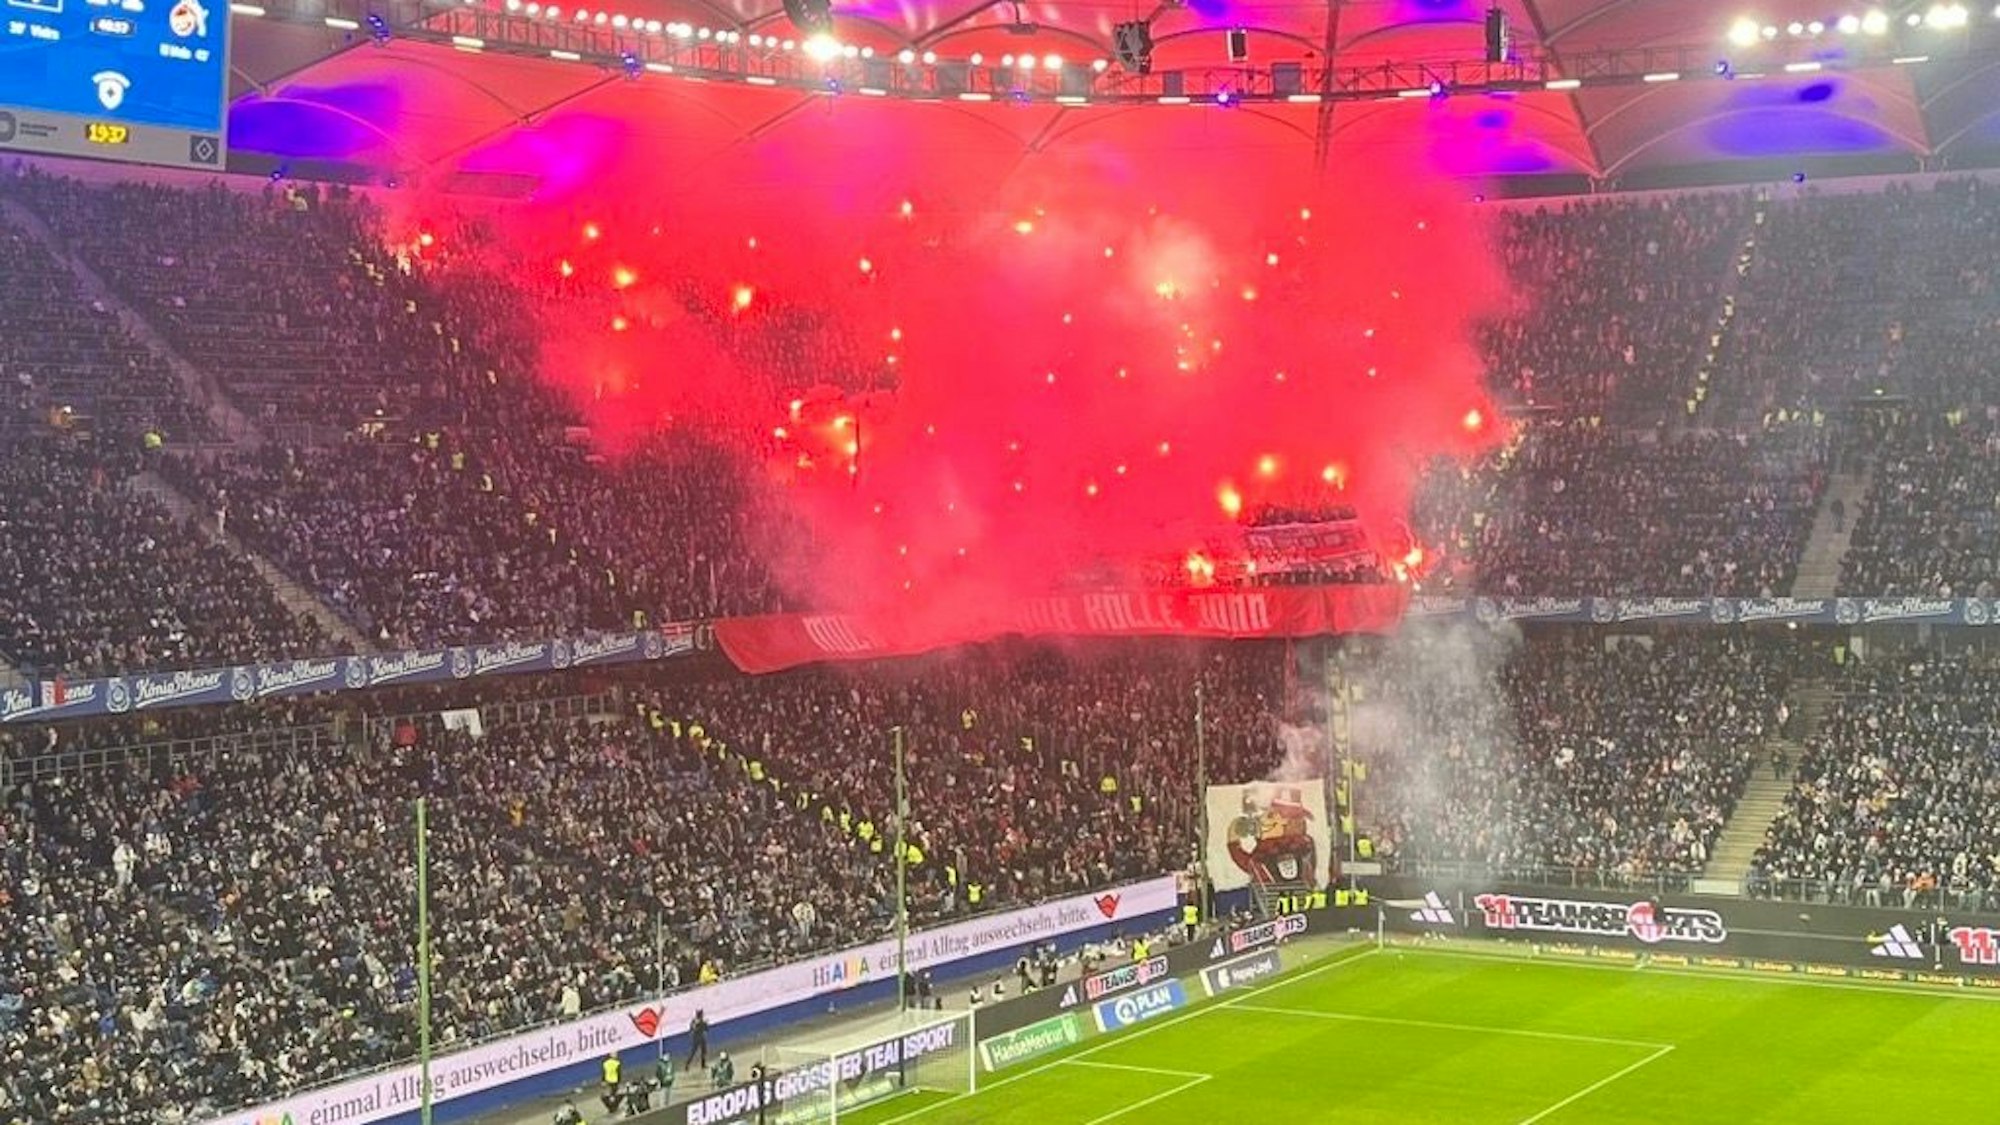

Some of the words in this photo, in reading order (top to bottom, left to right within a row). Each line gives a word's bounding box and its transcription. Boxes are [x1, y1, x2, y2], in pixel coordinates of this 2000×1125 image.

[1138, 985, 1172, 1012] PLAN
[309, 1085, 382, 1125] einmal
[385, 1074, 446, 1107] Alltg
[451, 1036, 573, 1088] auswechseln,
[577, 1025, 623, 1052] bitte.
